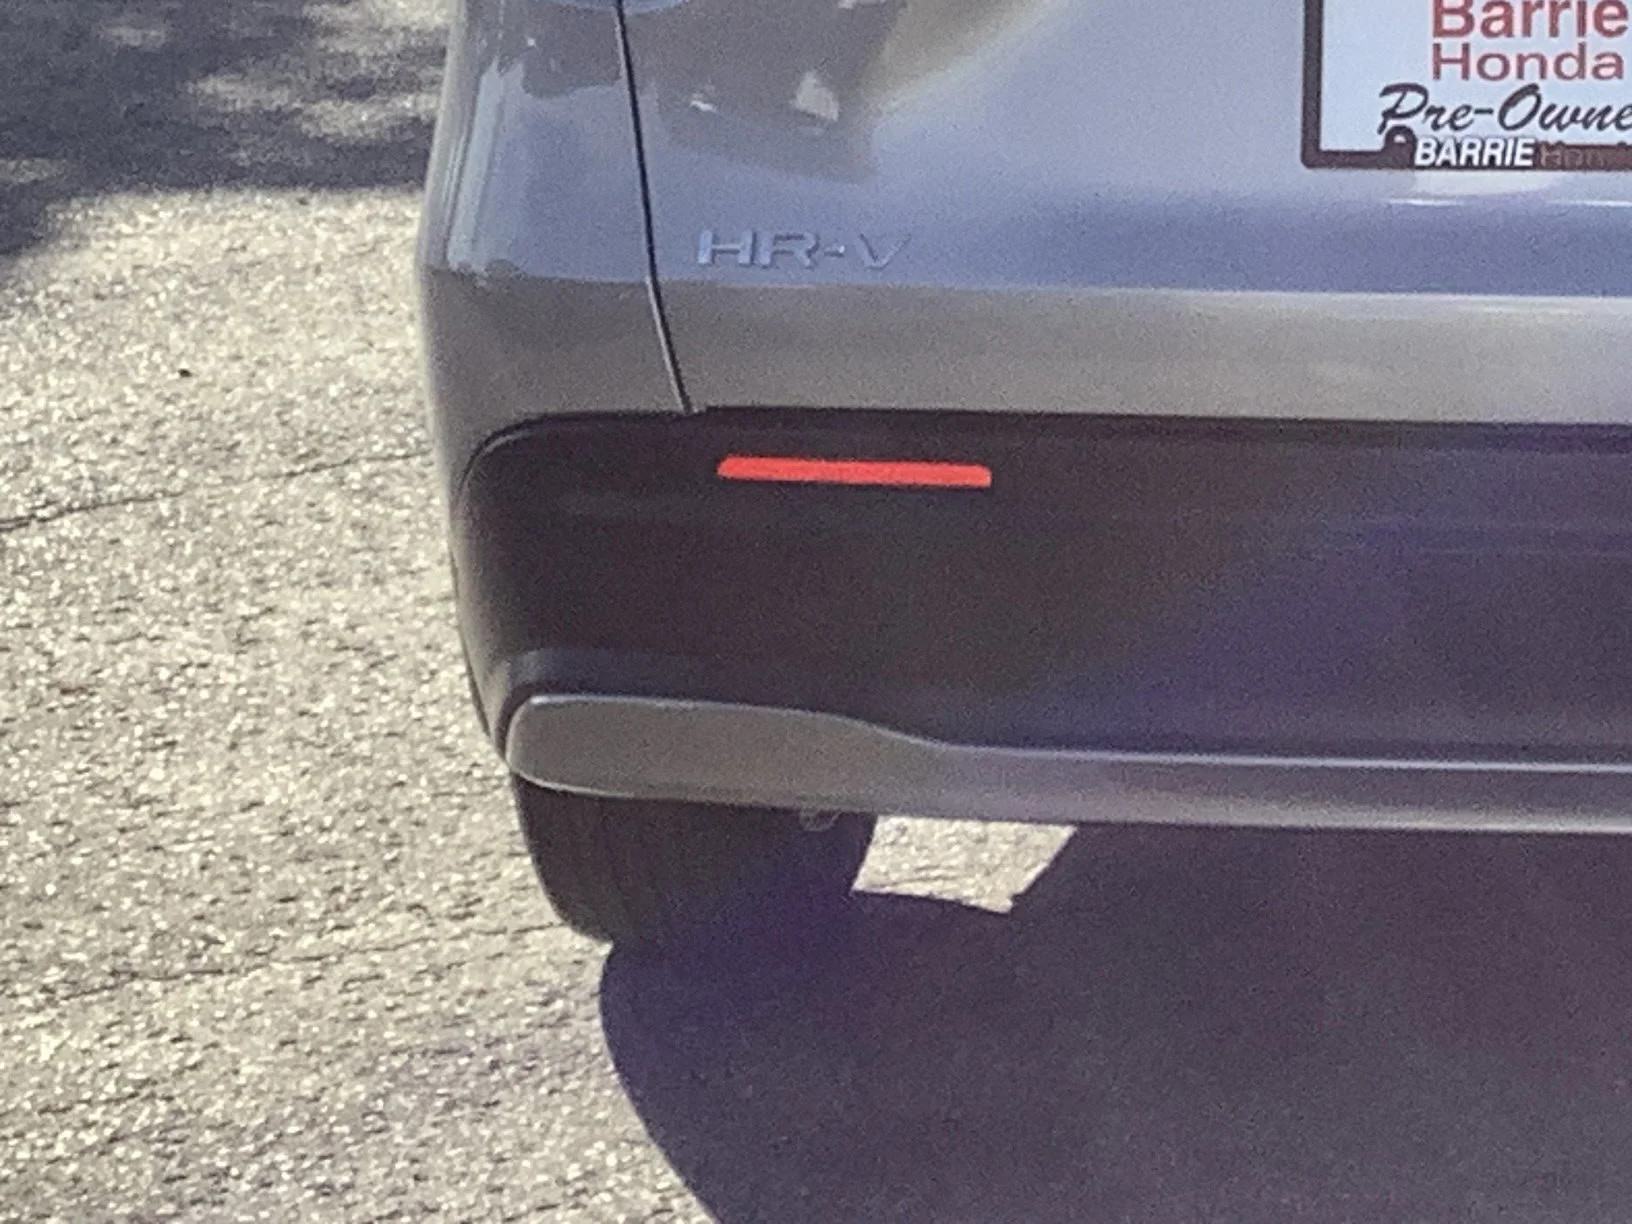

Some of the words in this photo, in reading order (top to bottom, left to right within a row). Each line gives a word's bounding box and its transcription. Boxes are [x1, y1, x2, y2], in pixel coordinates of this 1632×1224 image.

[1431, 43, 1625, 81] Honda
[1414, 137, 1535, 167] BARRIE
[697, 231, 911, 270] HR-V
